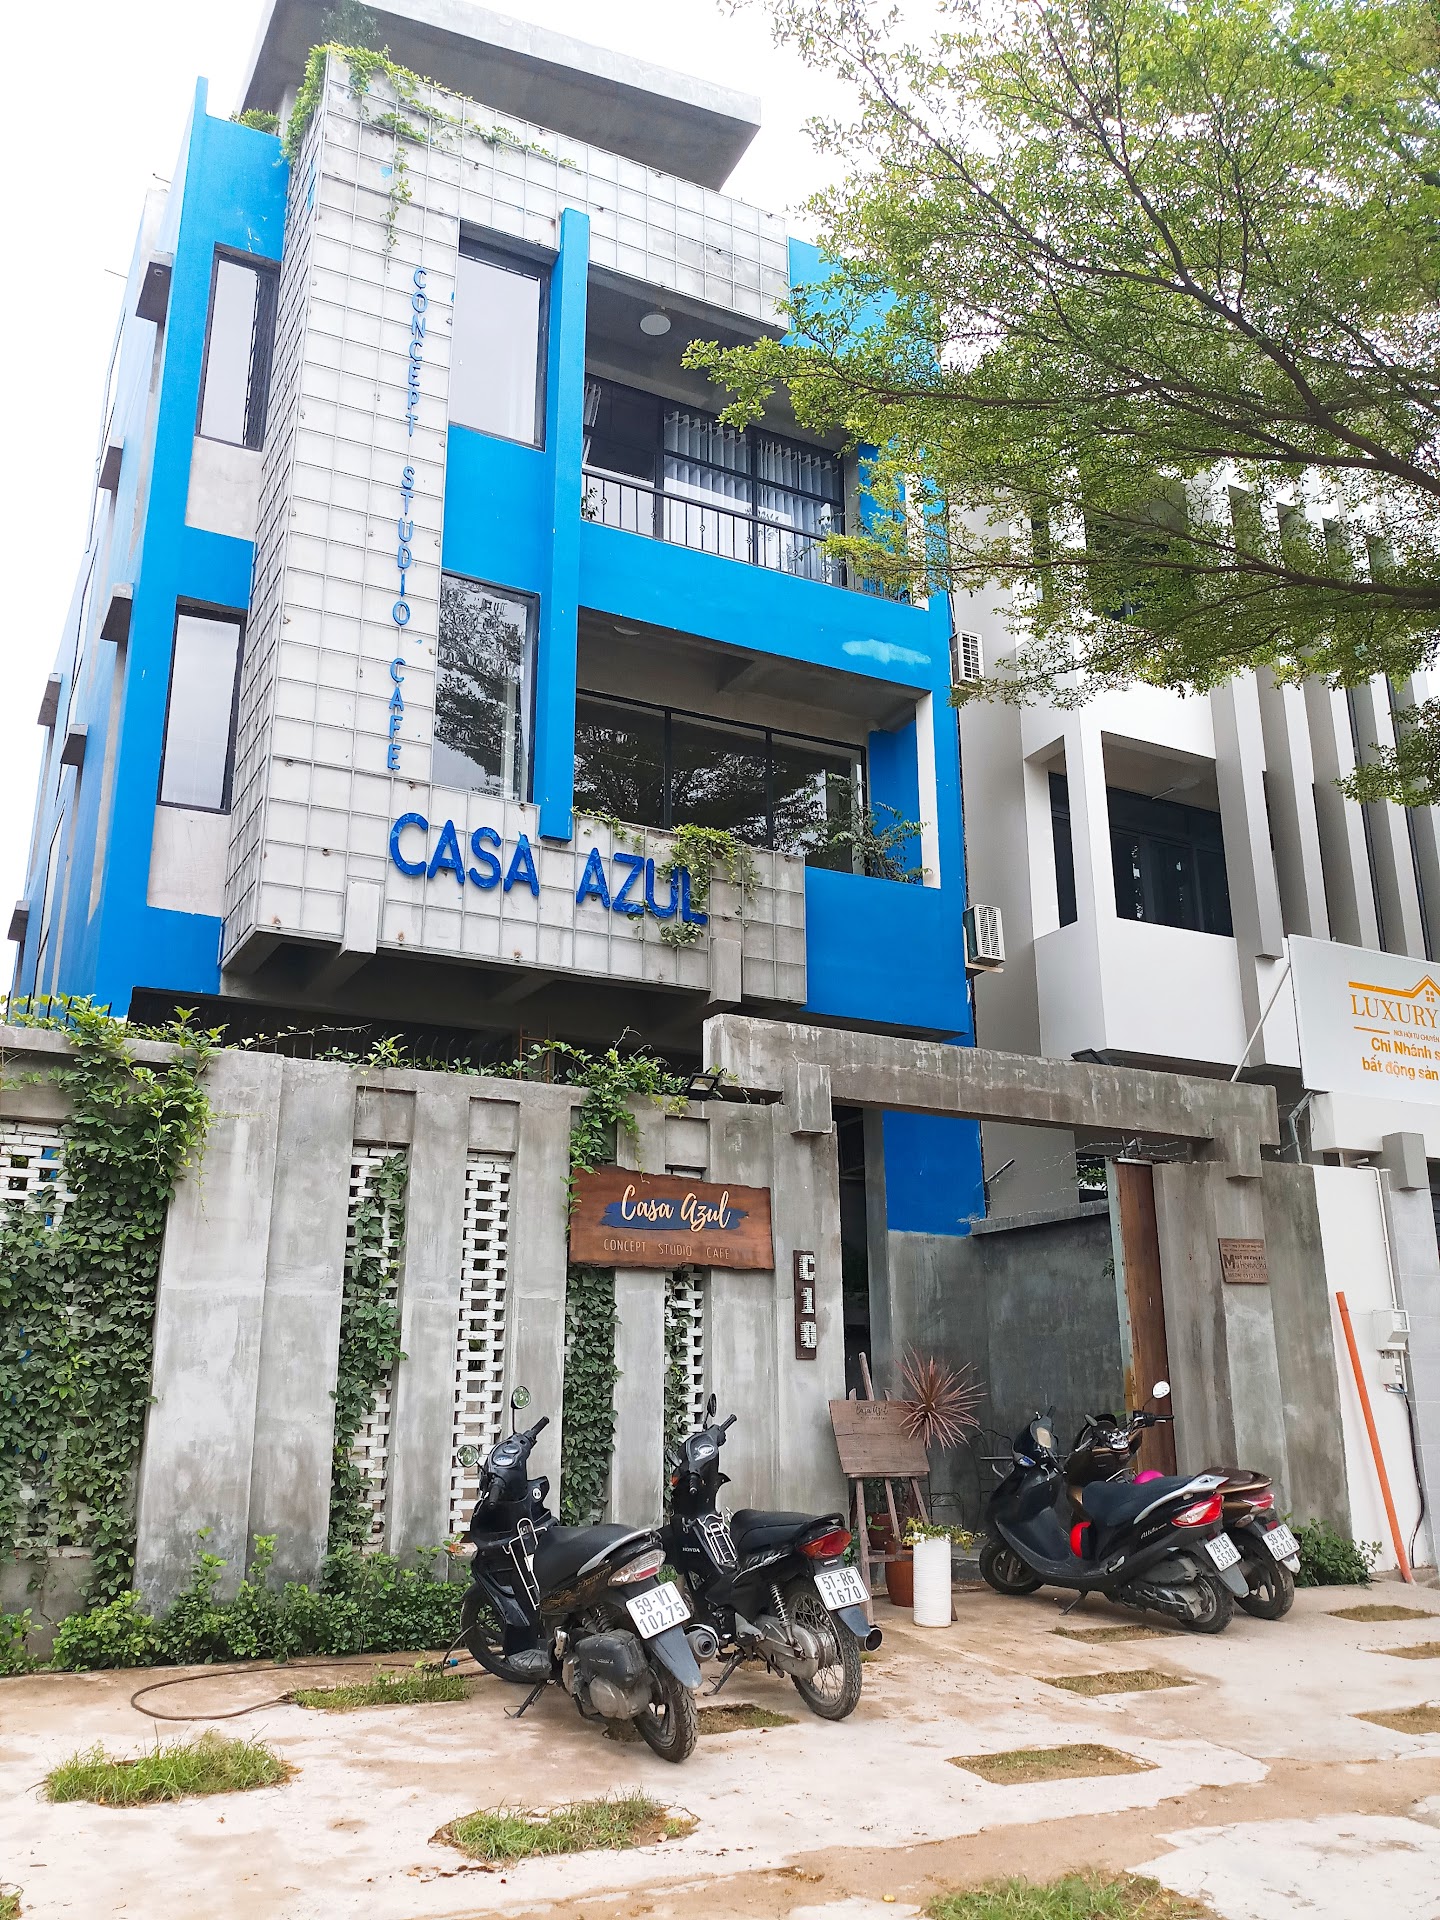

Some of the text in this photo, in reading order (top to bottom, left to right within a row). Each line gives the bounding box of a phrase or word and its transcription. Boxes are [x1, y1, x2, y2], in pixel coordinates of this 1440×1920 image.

[387, 268, 427, 771] CONCEPT STUDIO CAFE
[390, 812, 708, 925] CASA AZUL
[1350, 994, 1440, 1029] LUXURY
[1371, 1037, 1391, 1053] Chi
[1394, 1040, 1432, 1059] Nhánh
[1362, 1054, 1383, 1072] bất
[621, 1184, 731, 1232] Casa Azul
[604, 1238, 730, 1260] CONCEPT STUDIO CAFE
[682, 1546, 701, 1554] HONDA
[1217, 1548, 1237, 1566] 5530
[821, 1571, 855, 1591] 51-R6
[636, 1588, 673, 1615] 59-V1
[828, 1586, 862, 1606] 1670
[639, 1602, 686, 1634] 102.75
